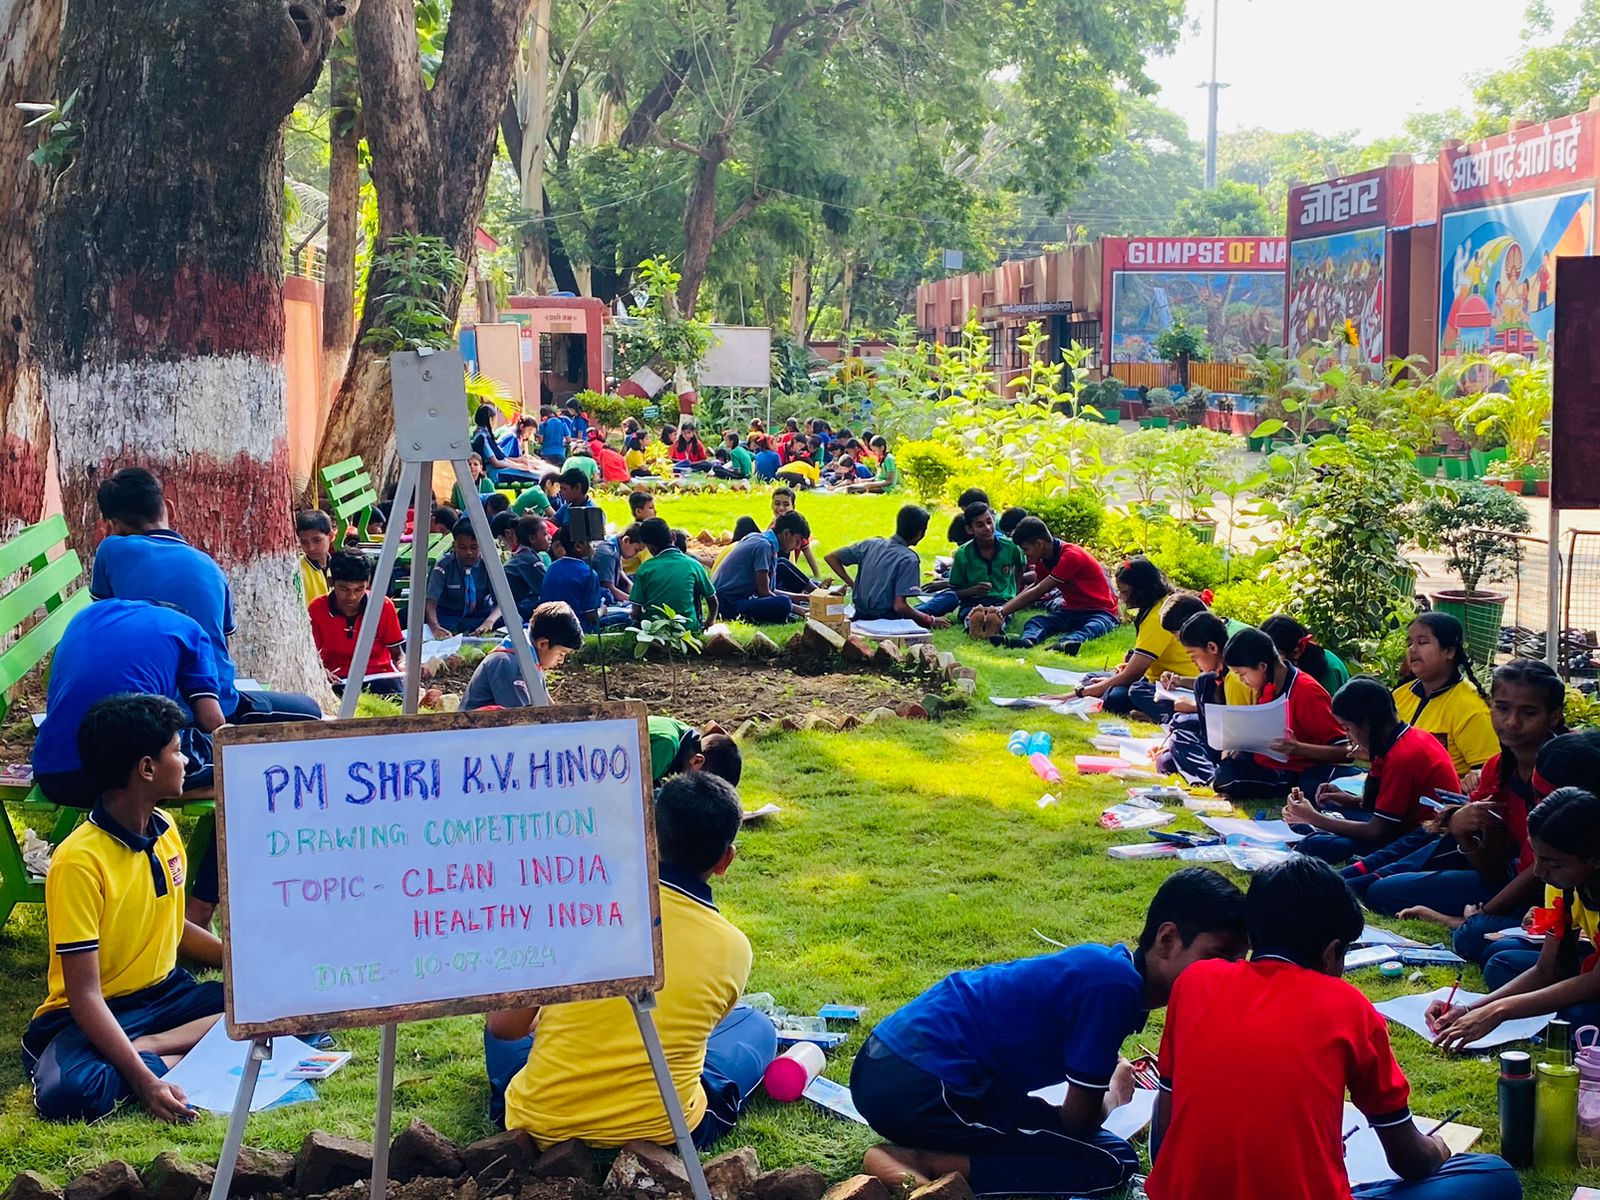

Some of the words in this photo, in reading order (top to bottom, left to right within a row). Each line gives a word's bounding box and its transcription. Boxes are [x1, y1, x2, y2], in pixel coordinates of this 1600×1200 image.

[1300, 177, 1380, 225] जोहार
[1128, 241, 1224, 264] GLIMPSE
[1228, 241, 1255, 264] OF
[264, 762, 328, 813] PM
[345, 757, 441, 805] SHRI
[462, 751, 520, 795] K.V.
[529, 743, 631, 790] HINOO
[267, 822, 408, 858] DRAWING
[424, 806, 597, 848] COMPETITION
[401, 859, 495, 898] CLEAN
[518, 853, 609, 888] INDIA
[413, 903, 533, 939] HEALTHY
[548, 901, 625, 930] INDIA
